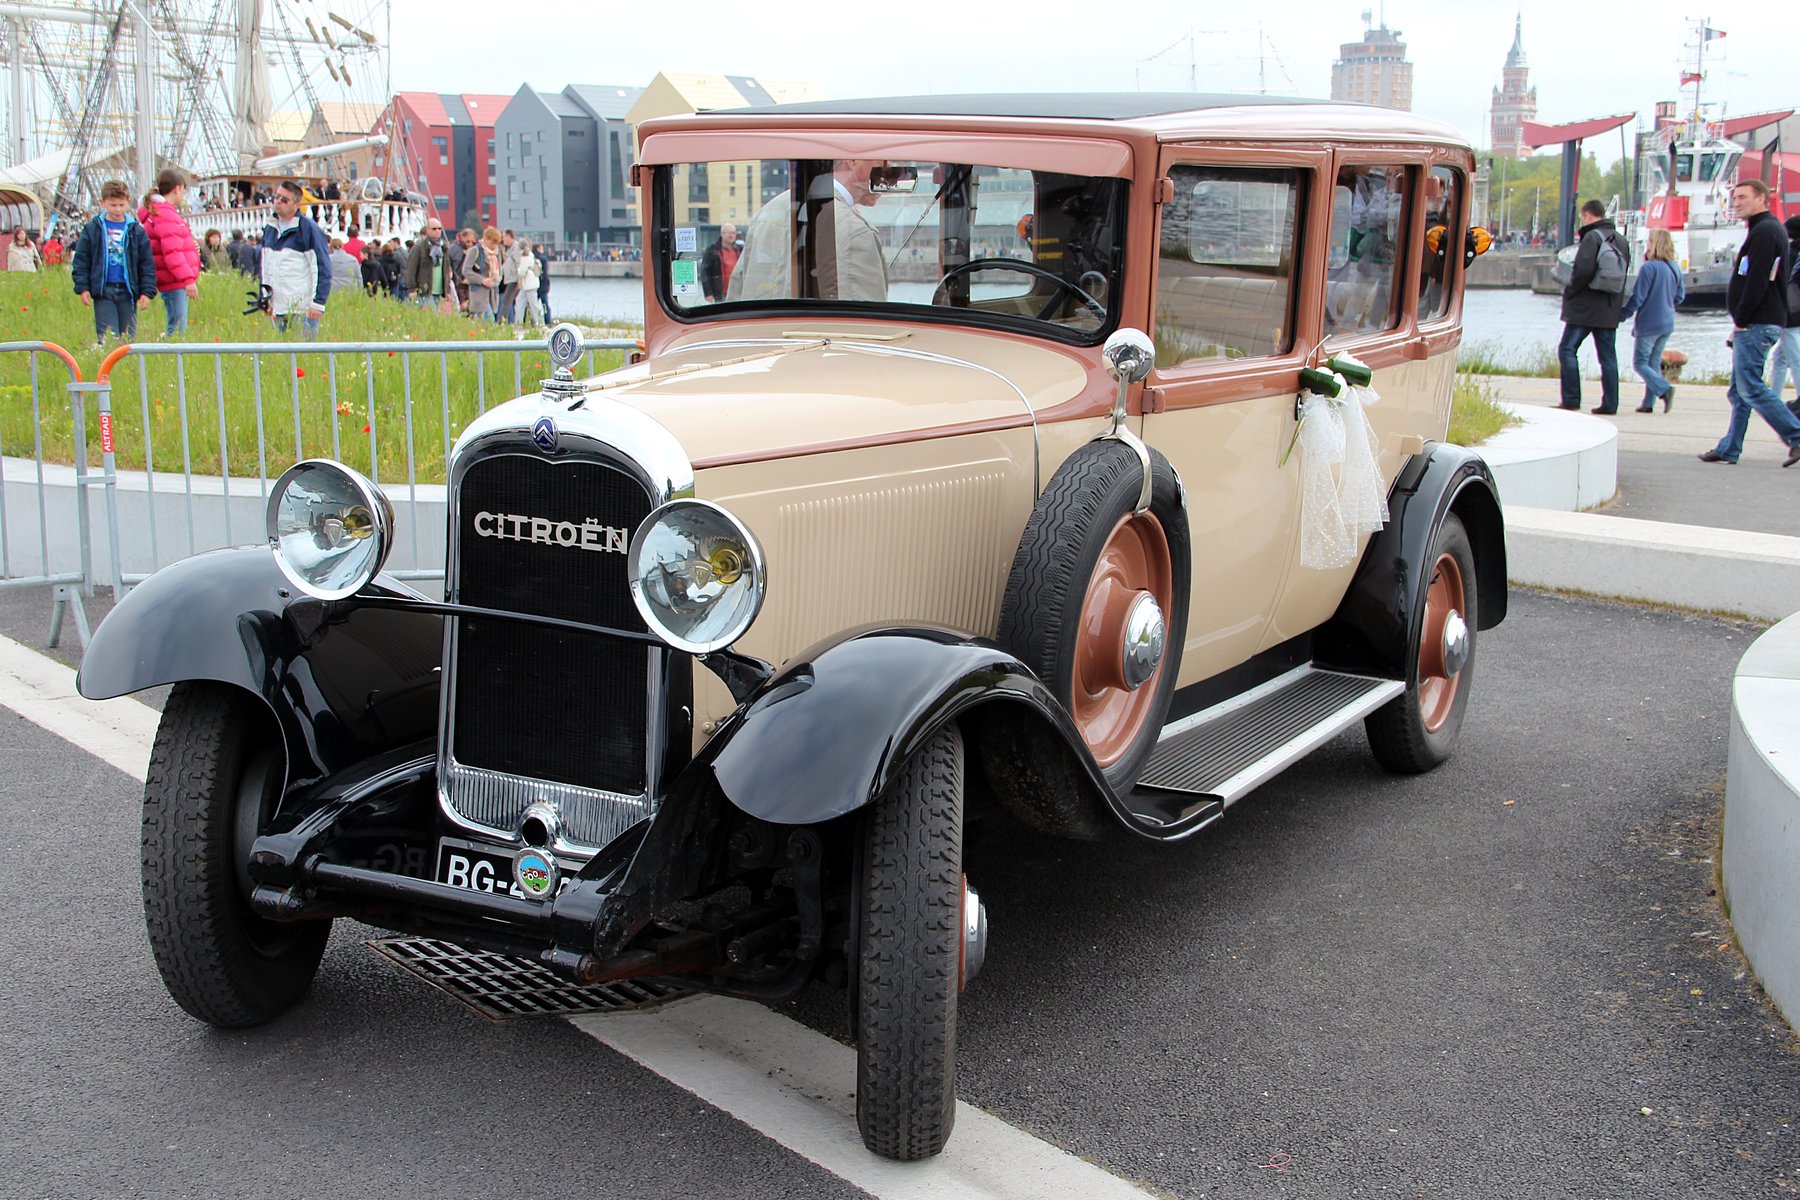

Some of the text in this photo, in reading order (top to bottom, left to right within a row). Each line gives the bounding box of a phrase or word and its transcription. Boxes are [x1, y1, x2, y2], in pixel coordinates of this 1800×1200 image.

[1651, 203, 1665, 219] 44
[102, 416, 111, 452] ALTRAD
[474, 511, 629, 555] CITROËN
